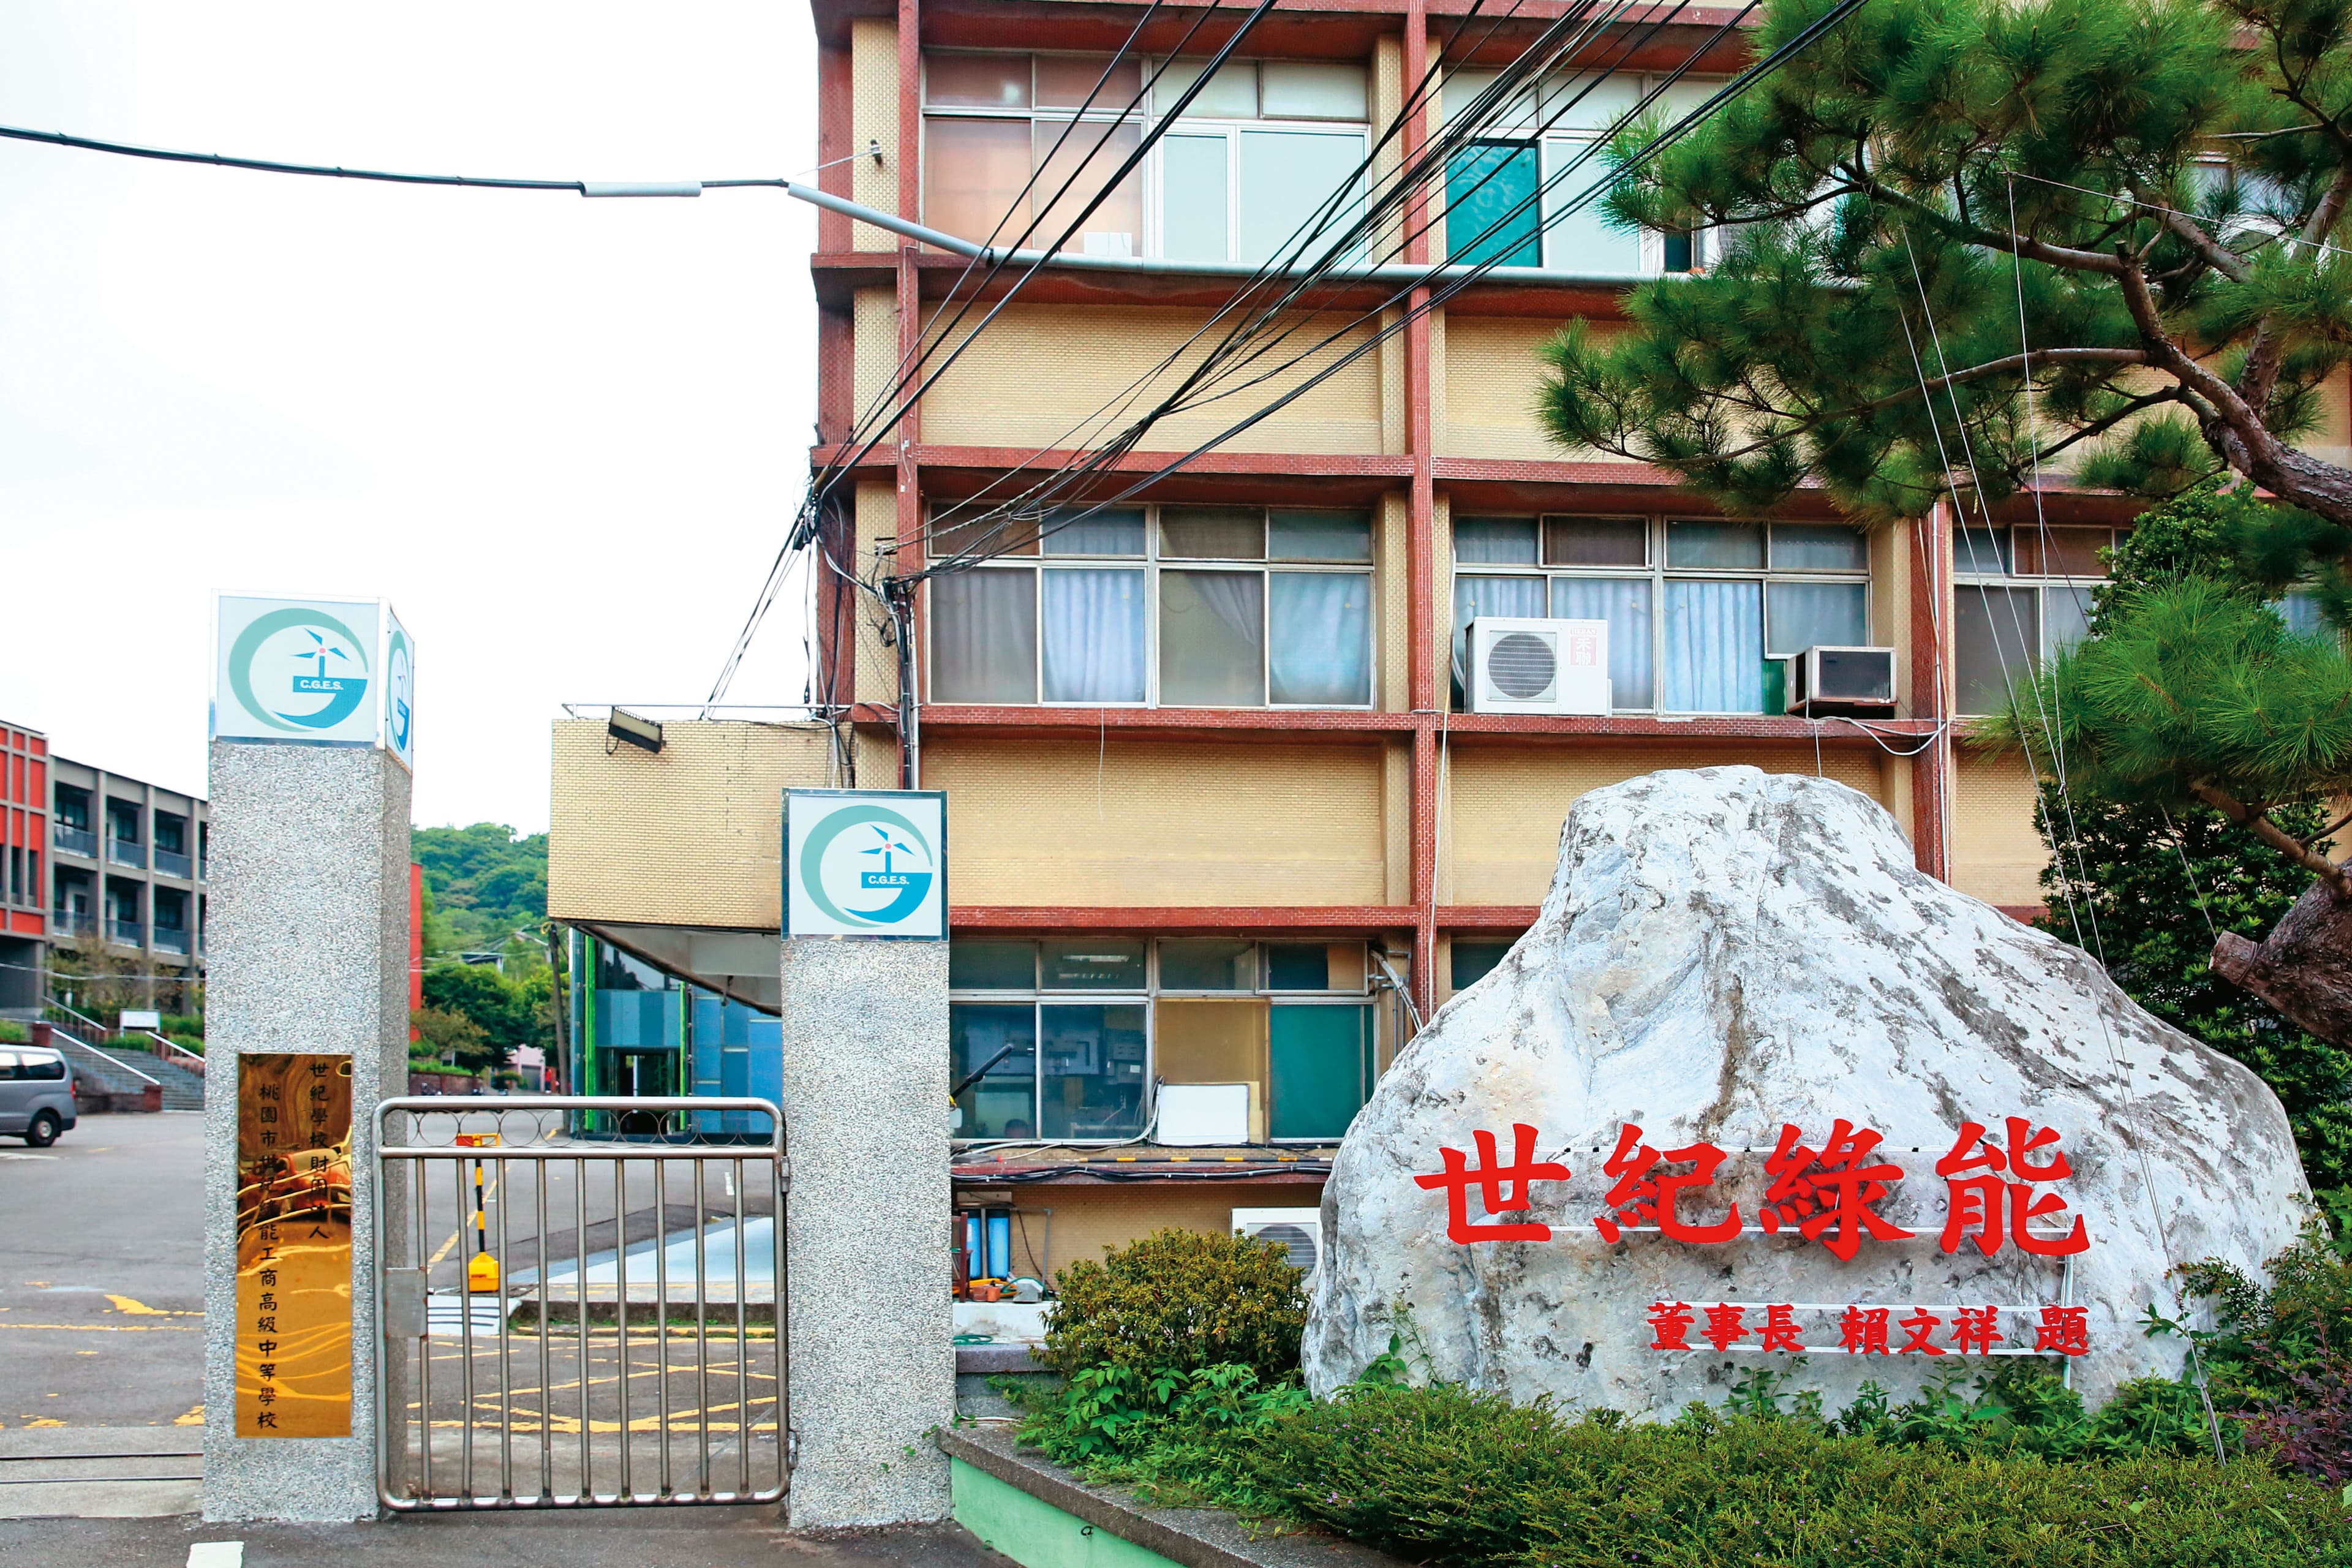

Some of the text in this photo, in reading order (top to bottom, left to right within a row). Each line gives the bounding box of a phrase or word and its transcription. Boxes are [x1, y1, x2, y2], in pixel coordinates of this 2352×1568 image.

[300, 679, 344, 690] C.G.E.S.
[868, 875, 910, 885] C.G.E.S.
[1414, 1116, 2090, 1261] 世紀綠能
[1647, 1302, 2090, 1356] 董事長 賴文祥 題
